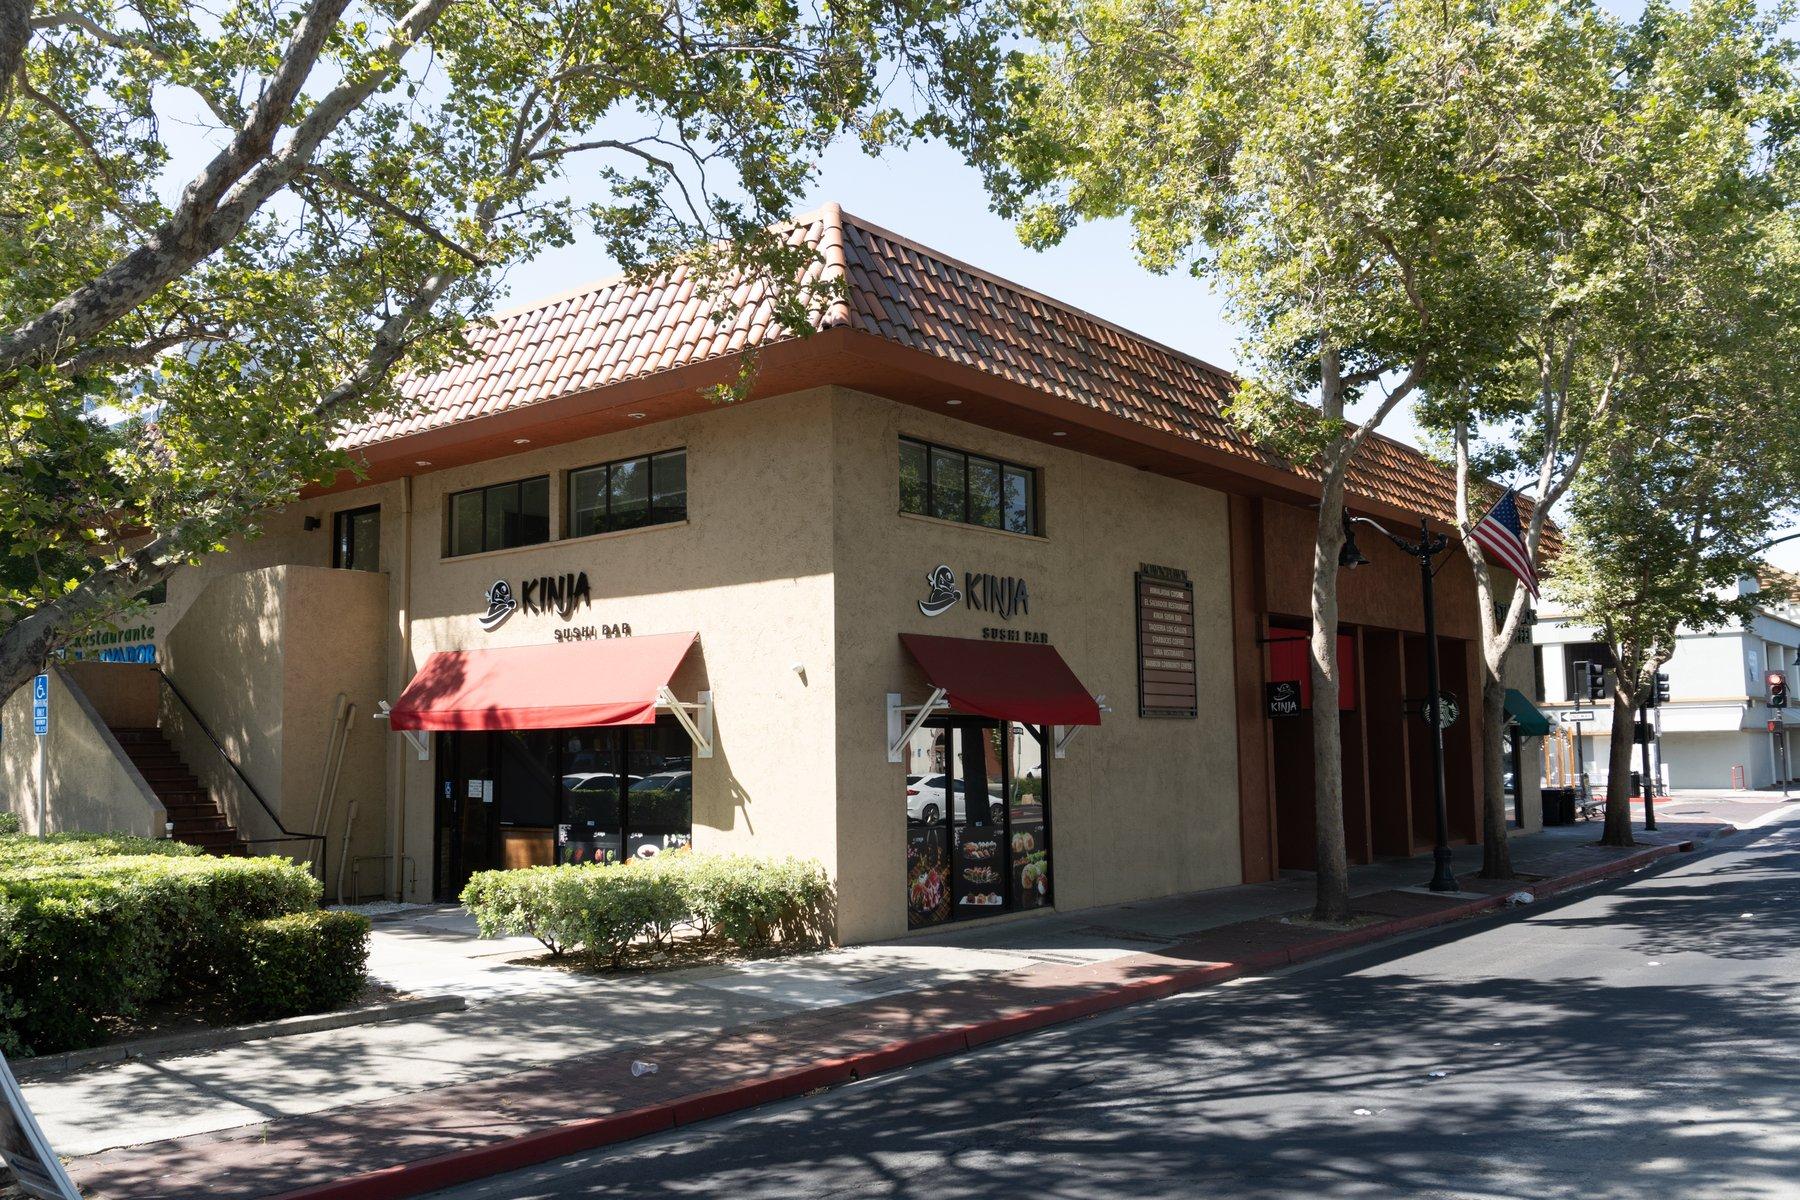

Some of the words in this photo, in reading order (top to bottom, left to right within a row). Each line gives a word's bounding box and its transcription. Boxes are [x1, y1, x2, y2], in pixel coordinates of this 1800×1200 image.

[521, 571, 591, 618] KINJA
[965, 572, 1030, 620] KINJA
[554, 625, 596, 641] SUSHI
[602, 622, 631, 637] BAR
[982, 627, 1020, 641] SUSHI
[1024, 630, 1048, 644] BAR
[1271, 701, 1296, 713] KINJA
